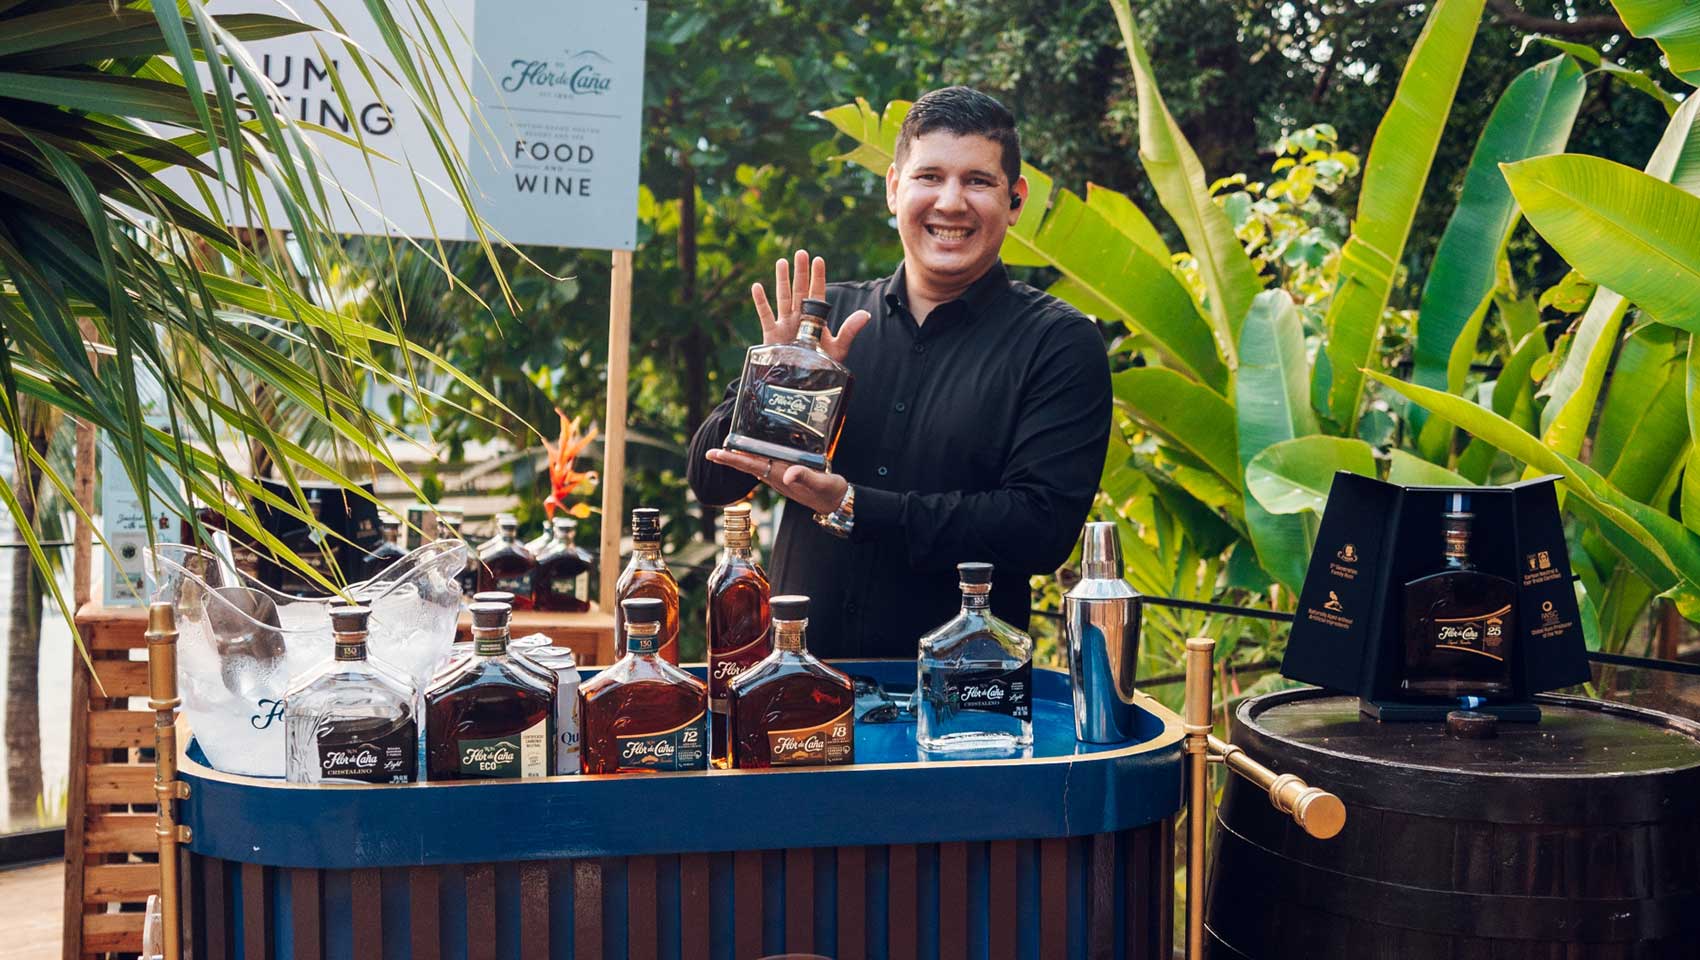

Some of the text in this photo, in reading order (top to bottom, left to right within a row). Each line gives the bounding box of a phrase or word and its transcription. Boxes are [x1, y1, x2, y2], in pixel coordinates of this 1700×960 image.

[227, 54, 338, 92] UM
[501, 59, 554, 93] Flor
[570, 64, 611, 95] Caña
[515, 140, 594, 164] FOOD
[515, 173, 591, 197] WINE
[1487, 626, 1502, 636] 25
[639, 640, 652, 649] 130
[714, 661, 740, 680] Flor
[961, 685, 982, 701] Flor
[987, 684, 1005, 701] Caña
[682, 730, 698, 743] 12
[832, 726, 847, 738] 18
[622, 741, 647, 759] Flor
[654, 740, 675, 757] Caña
[774, 737, 798, 754] Flor
[804, 735, 824, 752] Caña
[323, 751, 349, 769] Flor
[356, 750, 378, 768] Caña
[384, 760, 402, 770] Light
[463, 748, 487, 765] Flor
[494, 747, 514, 764] Caña
[327, 768, 373, 776] CRISTALINO
[479, 761, 497, 771] ECO
